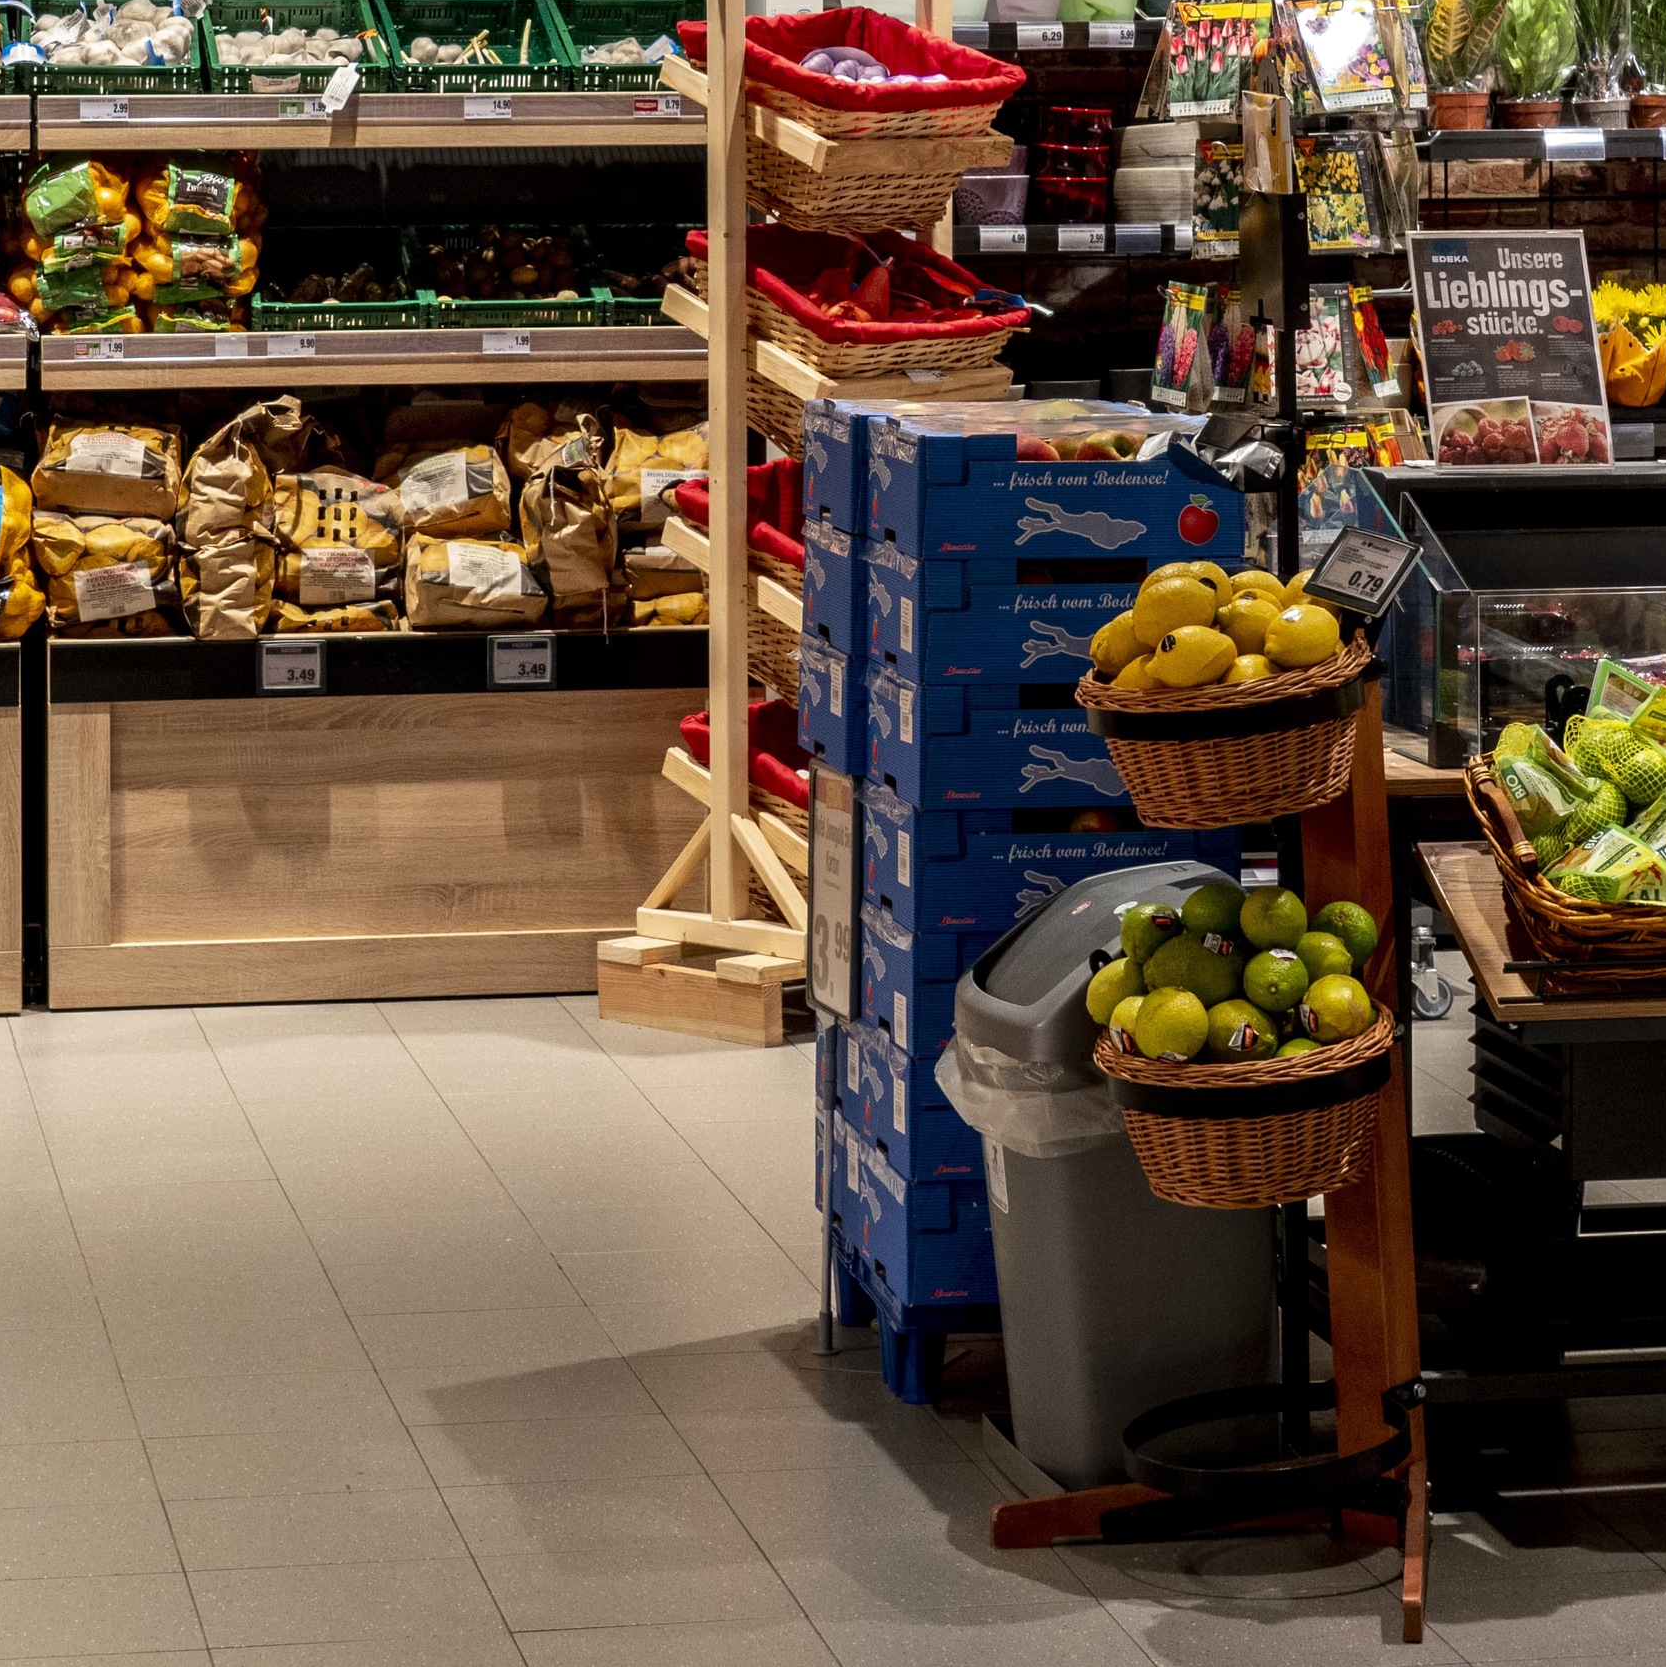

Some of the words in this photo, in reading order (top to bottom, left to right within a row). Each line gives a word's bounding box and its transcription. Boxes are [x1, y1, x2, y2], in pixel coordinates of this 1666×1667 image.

[1042, 31, 1062, 41] 6.29
[1120, 30, 1135, 40] 5.99
[113, 104, 128, 114] 2.99
[312, 102, 326, 112] 1.99
[493, 100, 511, 110] 14.90
[665, 99, 679, 109] 0.79
[201, 173, 225, 185] Bio
[186, 182, 219, 196] Zwiebeln
[1497, 248, 1563, 269] Unsere
[1423, 271, 1583, 316] Lieblings-
[1466, 311, 1544, 335] stücke.
[300, 339, 315, 349] 9.90
[515, 335, 529, 346] 1.99
[107, 342, 122, 353] 1.99
[1008, 469, 1054, 490] frisch
[1057, 475, 1088, 486] vom
[1093, 469, 1169, 486] Bodensee!
[1013, 593, 1059, 614] frisch
[1061, 598, 1093, 609] vom
[1097, 592, 1136, 609] Bode
[286, 668, 316, 681] 3.49
[517, 663, 546, 676] 3.49
[1013, 718, 1058, 739] frisch
[1504, 774, 1527, 800] BIO
[1585, 830, 1604, 851] BIO
[1008, 843, 1052, 864] frisch
[1055, 847, 1088, 858] vom
[1093, 841, 1169, 858] Bodensee!
